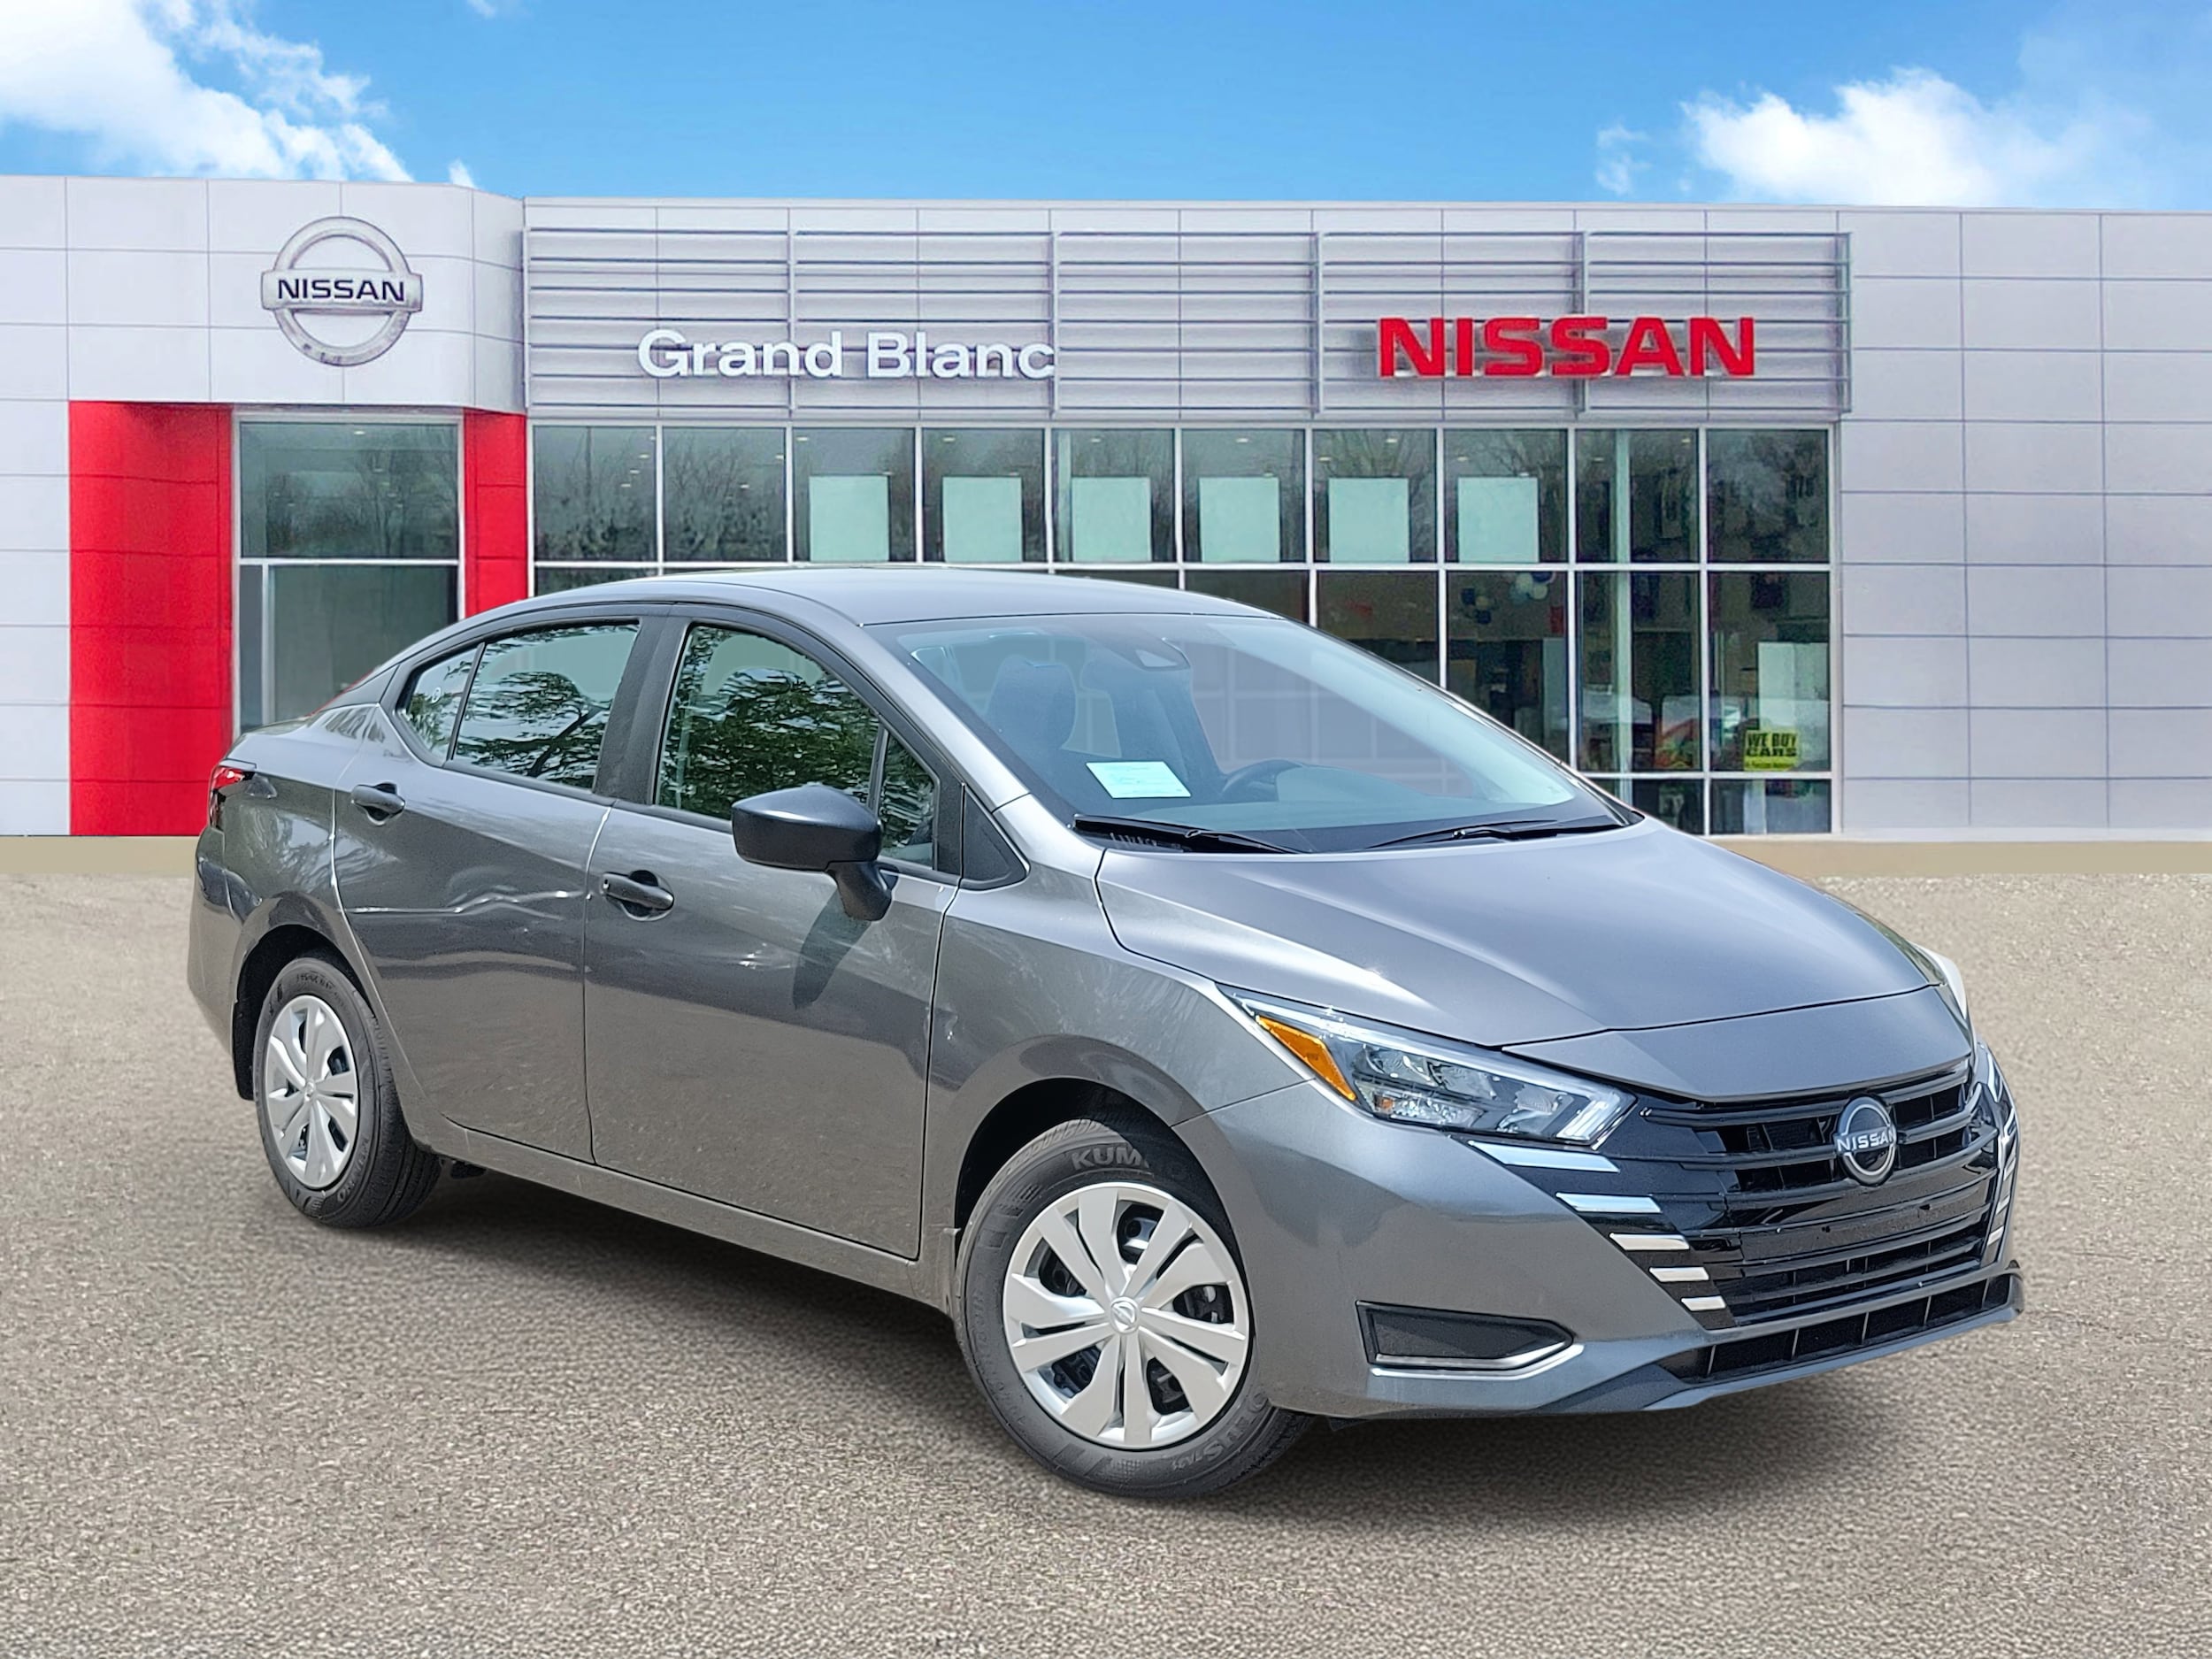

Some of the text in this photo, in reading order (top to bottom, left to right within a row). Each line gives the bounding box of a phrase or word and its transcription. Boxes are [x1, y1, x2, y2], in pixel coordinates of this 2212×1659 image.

[277, 278, 404, 303] NISSAN
[636, 328, 1056, 379] Grand Blanc
[1379, 316, 1755, 378] NISSAN
[1746, 747, 1798, 757] CARS
[1747, 733, 1798, 748] WE BUY
[1837, 1129, 1896, 1152] NISSAN
[1071, 1146, 1150, 1170] KUM
